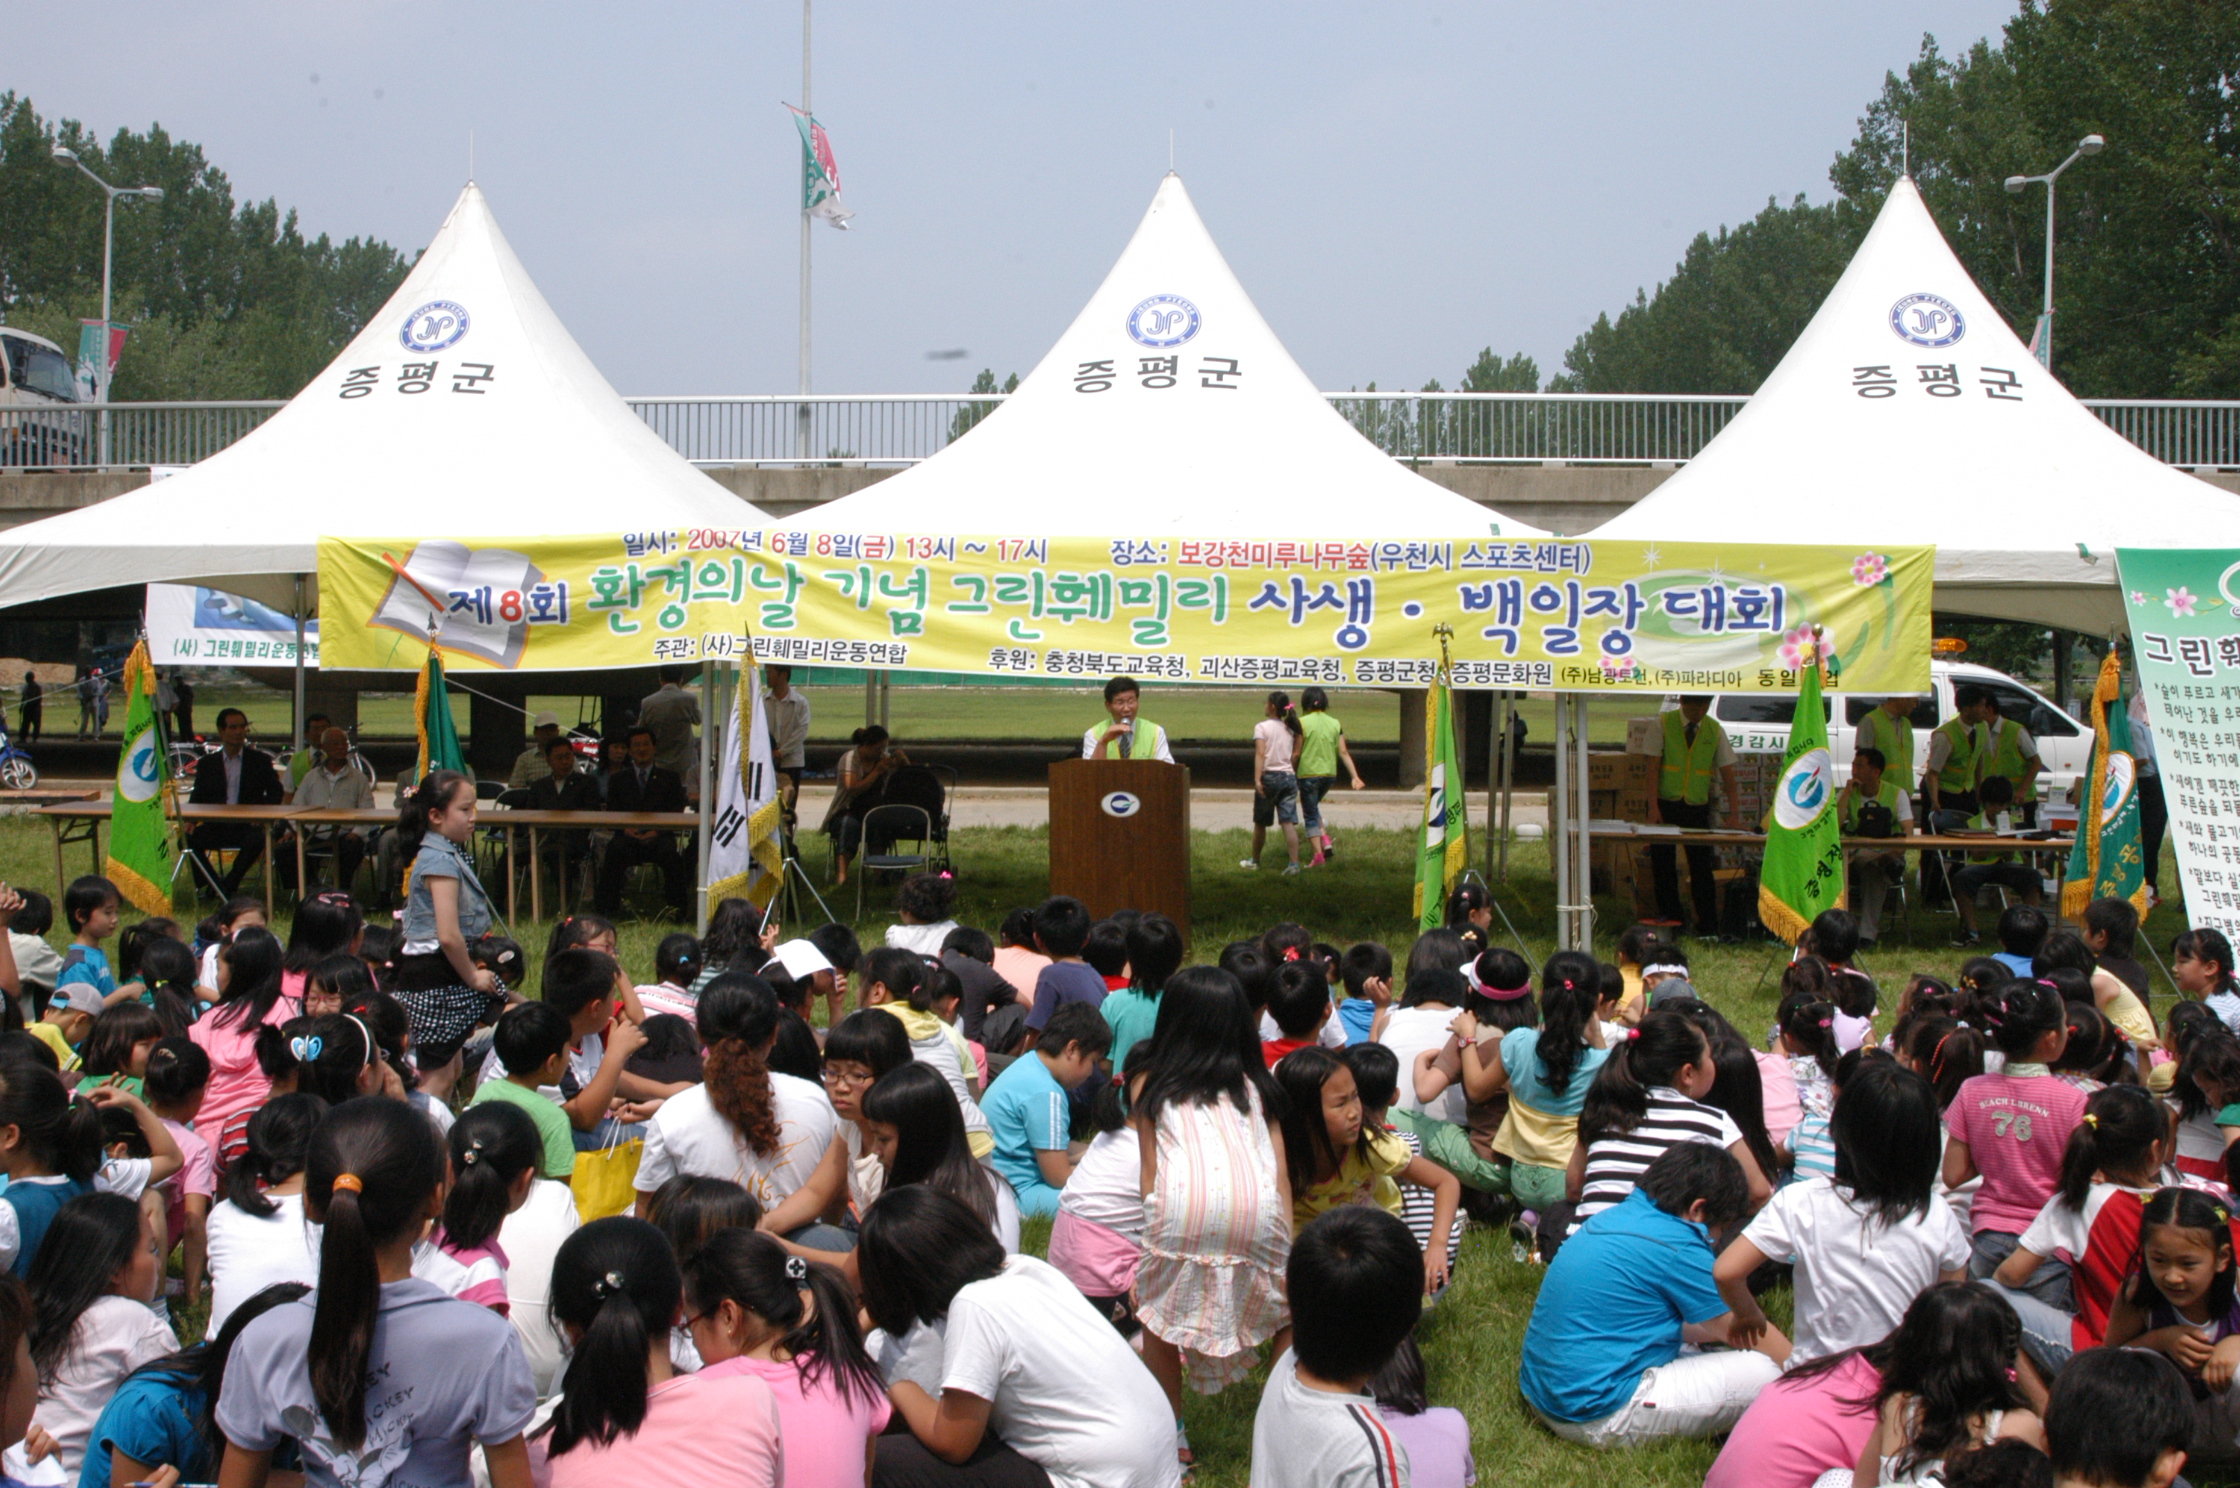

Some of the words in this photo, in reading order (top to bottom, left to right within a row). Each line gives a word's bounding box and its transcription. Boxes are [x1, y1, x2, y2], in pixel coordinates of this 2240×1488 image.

[339, 361, 495, 399] 증평군
[1073, 355, 1242, 393] 증평군
[1852, 363, 2023, 401] 증평군
[623, 531, 676, 556] 일시:
[687, 528, 761, 551] 2007년
[772, 532, 807, 556] 6월
[816, 534, 894, 560] 8일(금)
[906, 537, 954, 561] 13시
[997, 539, 1046, 563] 17시
[1111, 540, 1167, 565] 장소:
[1178, 541, 1450, 571] 보강천미루나무숲(우천시
[1460, 544, 1591, 575] 스포츠센터)
[448, 583, 566, 624] 제8회
[823, 566, 927, 636] 기념
[948, 571, 1226, 645] 그린훼밀리
[1249, 576, 1372, 650] 사생
[1459, 579, 1645, 656] 백일장
[1663, 584, 1783, 632] 대회
[173, 638, 198, 657] (사)
[653, 638, 695, 659] 주관:
[989, 648, 1035, 672] 후원:
[1045, 651, 1190, 678] 충청북도교육청,
[1200, 658, 1346, 684] 괴산증평교육청,
[1450, 662, 1552, 685] 증평문화원
[1655, 669, 1741, 687] (주)파라디아
[2184, 686, 2215, 700] 푸르고
[2207, 823, 2240, 843] 물고기
[1991, 1110, 2032, 1142] 76
[366, 1386, 415, 1426] ICKEY
